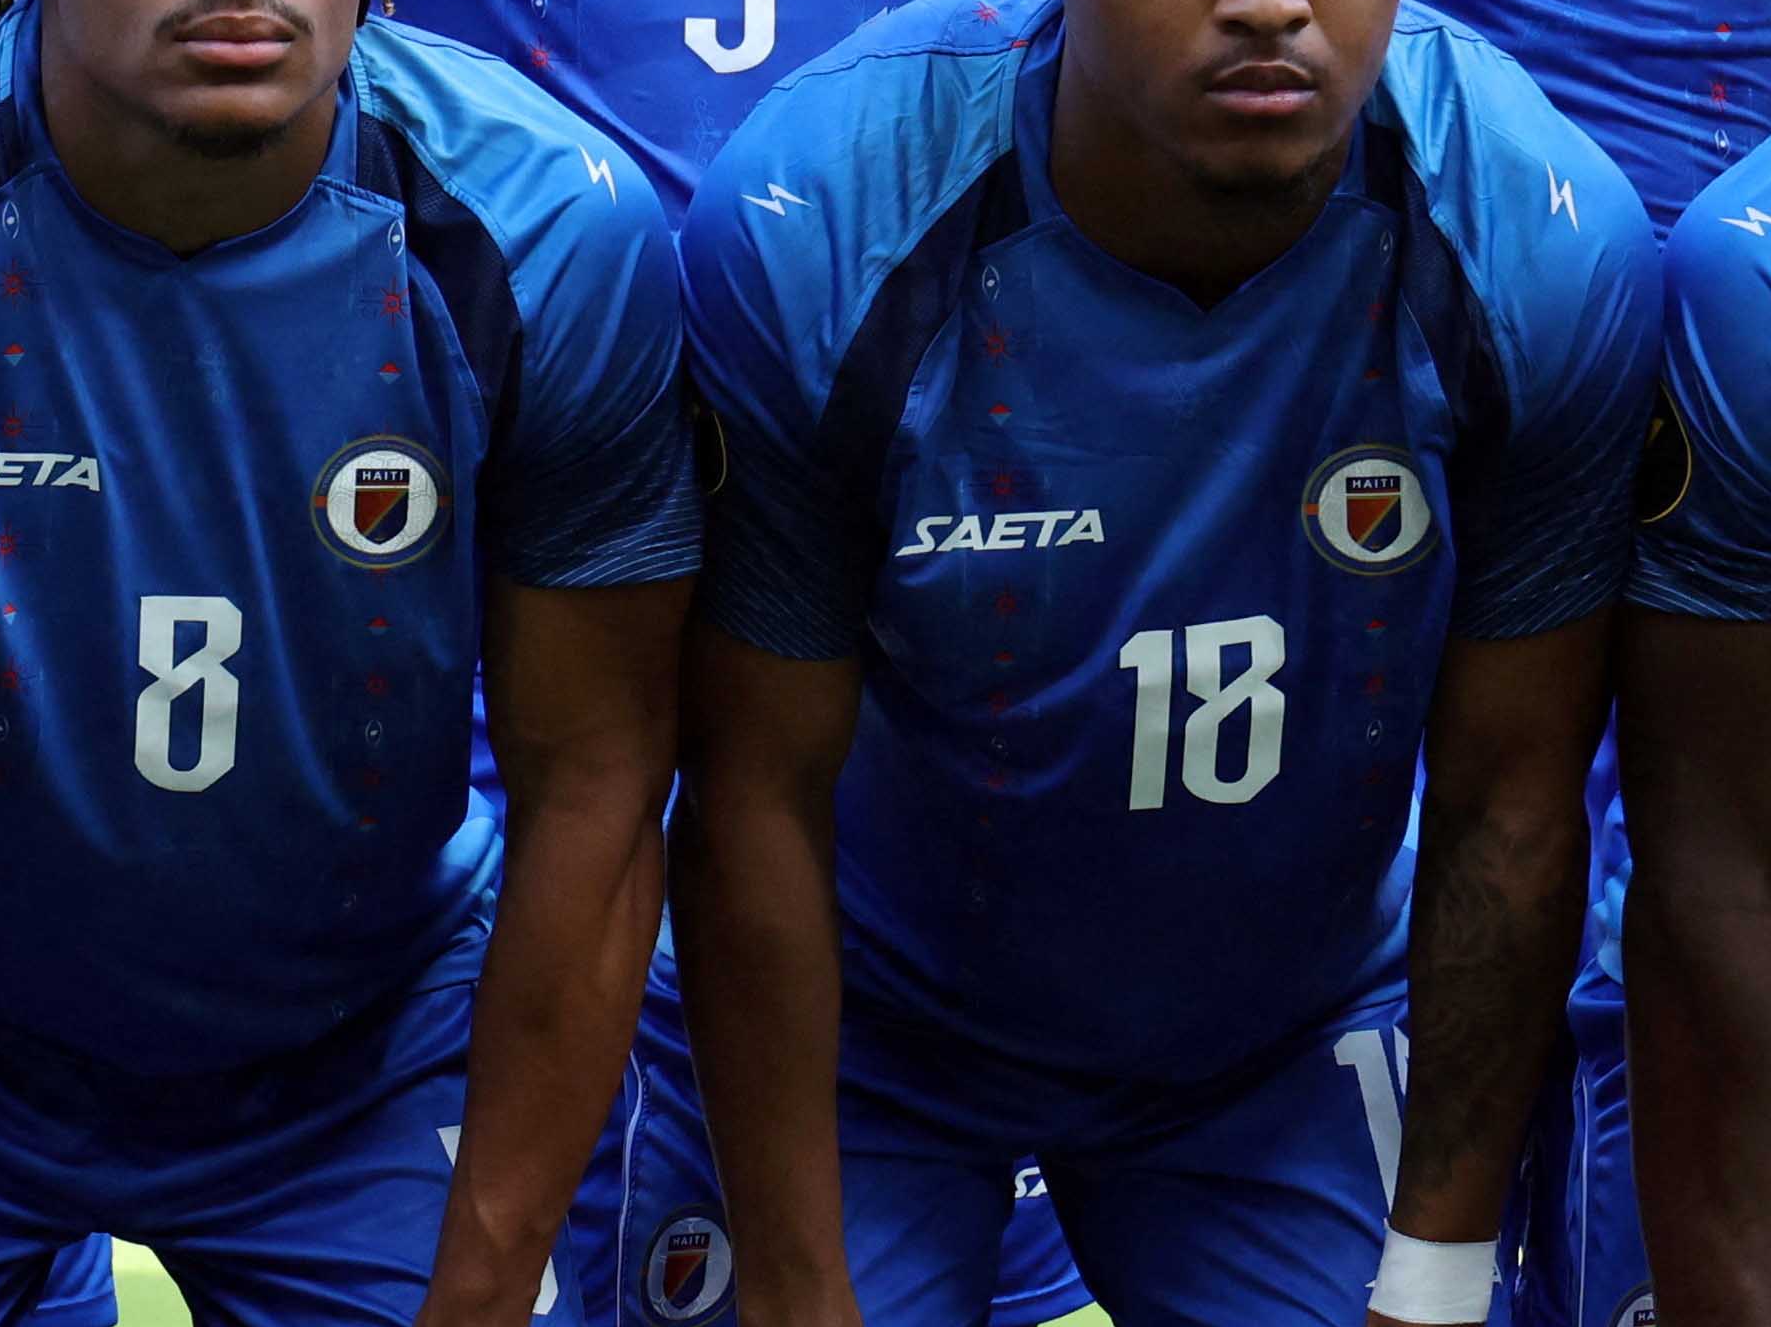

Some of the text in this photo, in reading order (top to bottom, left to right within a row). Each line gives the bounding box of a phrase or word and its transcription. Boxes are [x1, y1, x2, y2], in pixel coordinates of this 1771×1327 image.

[362, 469, 404, 483] HAITI
[1352, 477, 1395, 490] HAITI
[895, 509, 1105, 557] SAETA
[133, 595, 242, 793] 8
[1119, 614, 1285, 811] 18
